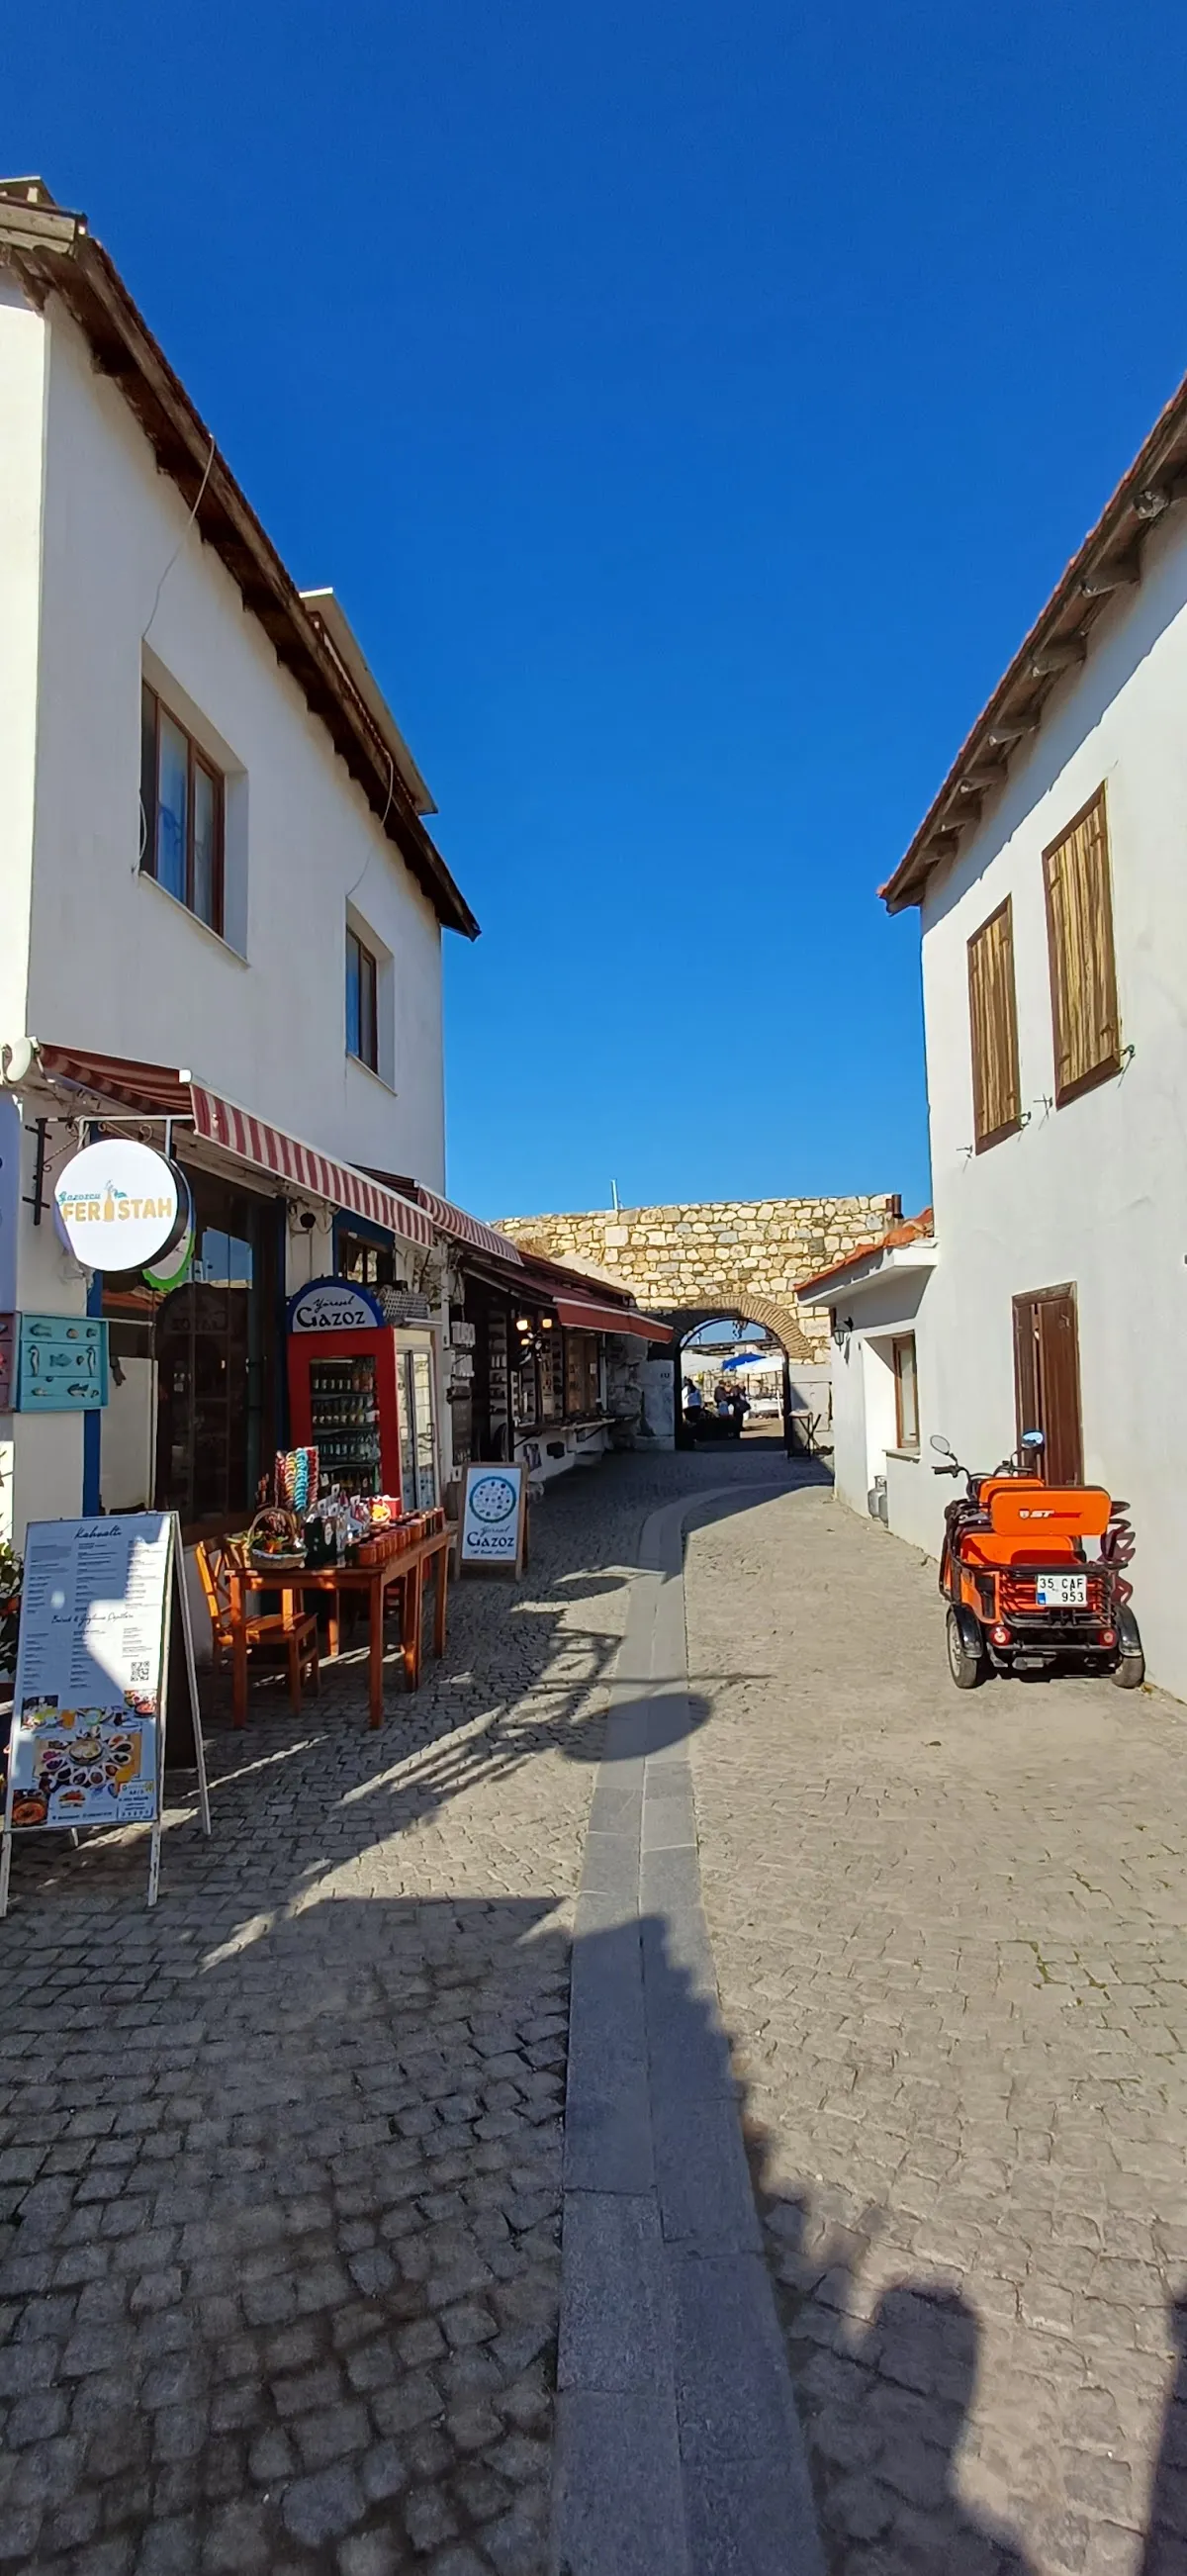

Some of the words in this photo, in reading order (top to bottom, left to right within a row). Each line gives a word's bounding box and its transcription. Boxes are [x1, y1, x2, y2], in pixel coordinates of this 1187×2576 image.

[1040, 1578, 1054, 1589] 35
[1061, 1578, 1083, 1590] CAF
[1061, 1591, 1084, 1603] 953
